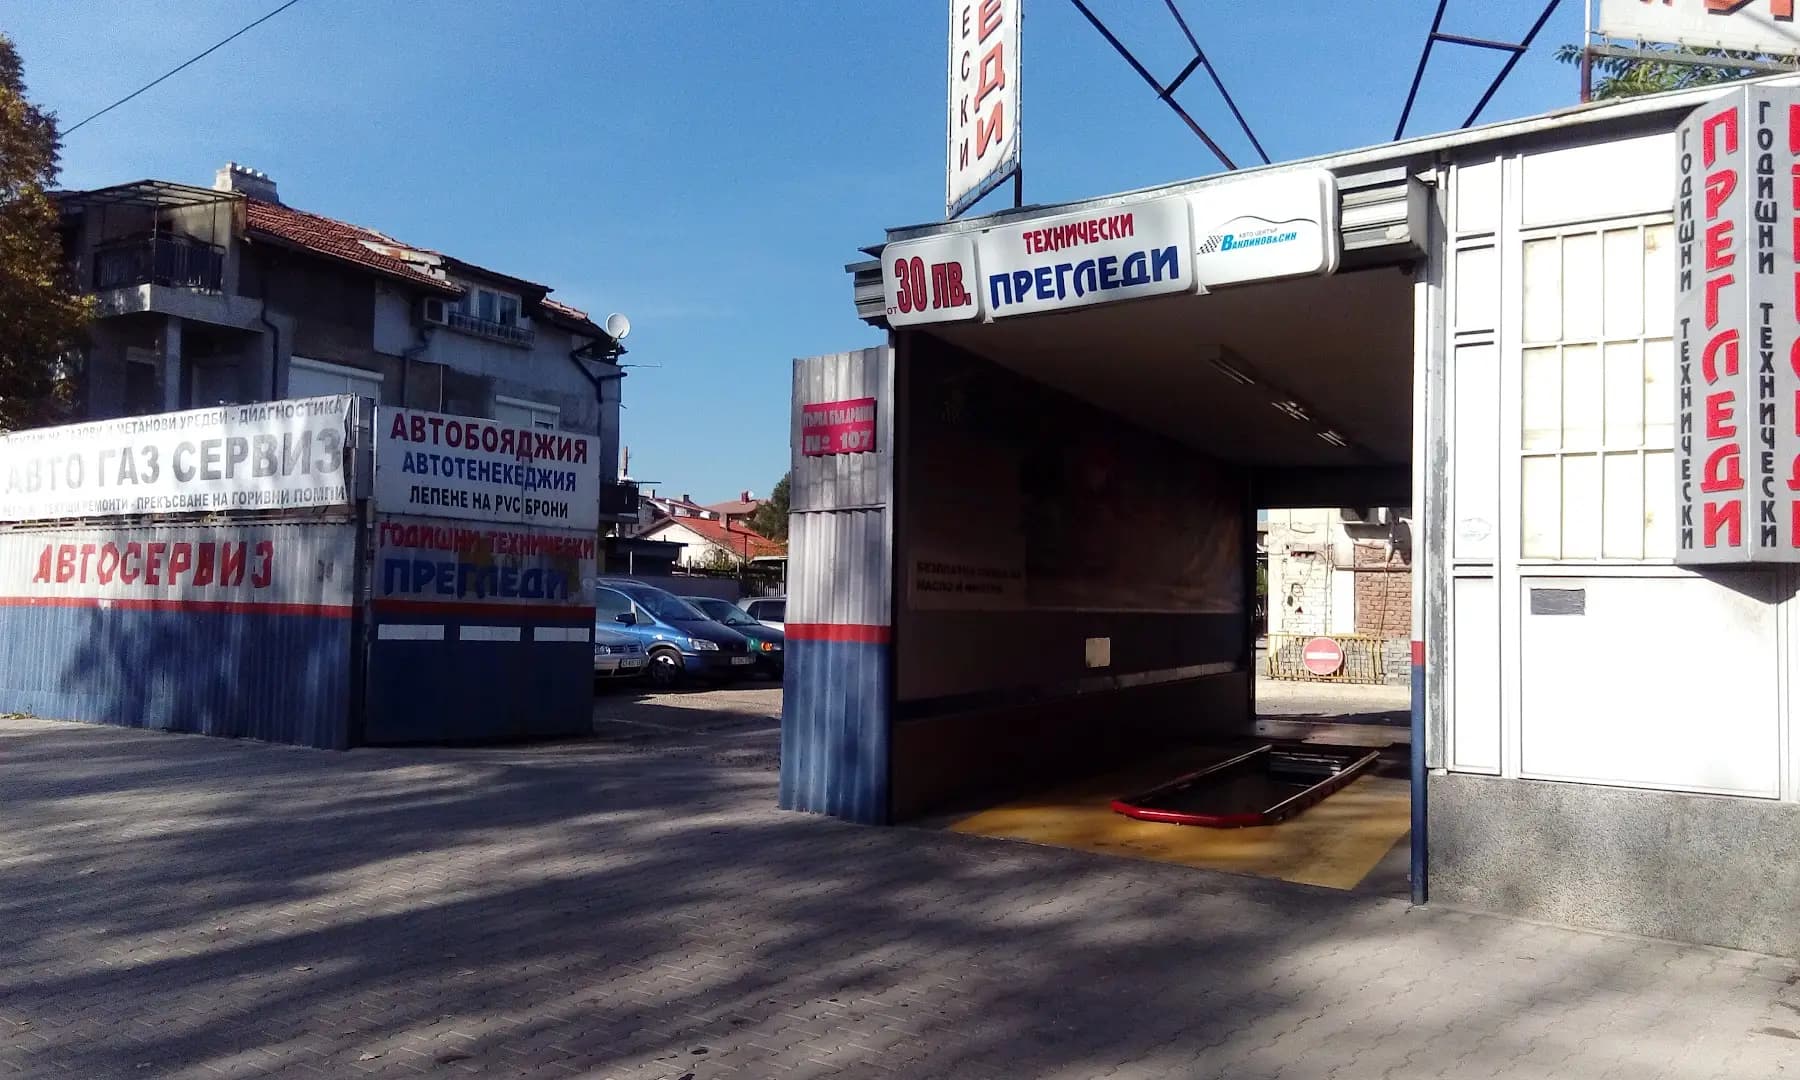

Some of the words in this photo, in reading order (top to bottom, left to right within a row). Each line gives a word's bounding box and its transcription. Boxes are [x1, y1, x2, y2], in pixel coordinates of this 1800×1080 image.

[1678, 127, 1695, 293] ГОДИШНИ
[1754, 100, 1778, 275] ГОДИШНИ
[1022, 213, 1134, 255] ТЕХНИЧЕСКИ
[894, 256, 927, 314] 30
[931, 261, 972, 310] ЛВ.
[989, 245, 1180, 311] ПРЕГЛЕДИ
[1701, 106, 1745, 549] ПРЕГЛЕДИ
[117, 416, 177, 436] МЕТАНОВИ
[180, 411, 228, 431] УРЕДБИ
[238, 399, 345, 426] ДИАГНОСТИКА
[390, 413, 588, 465] АВТОБОЯДЖИЯ
[839, 430, 872, 450] 107
[1679, 317, 1694, 550] ТЕХНИЧЕСКИ
[1759, 302, 1777, 548] ТЕХНИЧЕСКИ
[6, 451, 86, 495] АВТО
[98, 445, 160, 487] ГАЗ
[172, 427, 342, 483] СЕРВИЗ
[402, 451, 577, 493] АВТОТЕНЕКЕДЖИЯ
[137, 493, 209, 510] ПРЕКЪСВАНЕ
[213, 492, 229, 506] НА
[232, 488, 289, 506] ГОРИВНИ
[294, 485, 345, 503] ПОМПИ
[410, 485, 468, 508] ЛЕПЕНЕ
[473, 494, 491, 511] НА
[495, 496, 521, 513] PVC
[525, 498, 568, 519] БРОНИ
[33, 540, 274, 589] АВТОСЕРВИЗ
[379, 521, 480, 553] ГОДИШНИ
[488, 531, 595, 560] ТЕХНИЧЕСКИ
[384, 557, 569, 600] ПРЕГЛЕДИ
